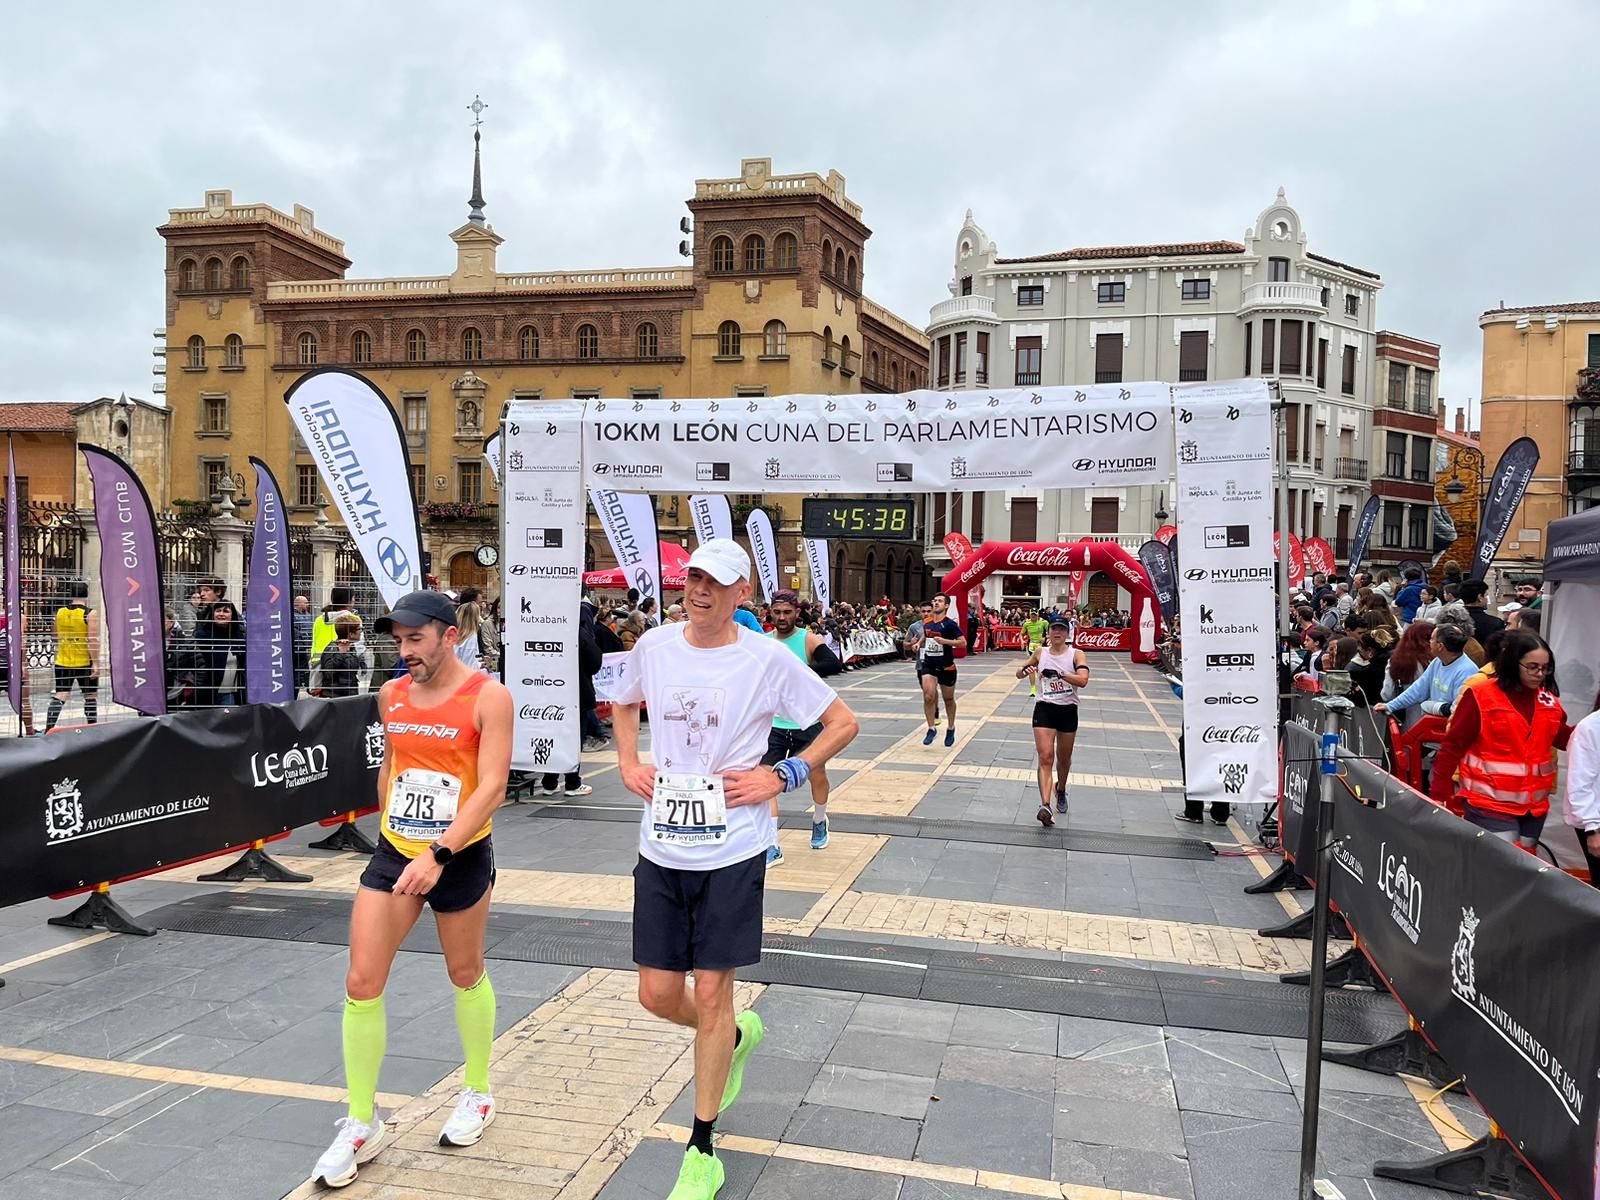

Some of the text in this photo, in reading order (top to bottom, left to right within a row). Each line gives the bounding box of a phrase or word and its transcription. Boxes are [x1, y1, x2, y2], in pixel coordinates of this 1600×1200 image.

[595, 412, 1156, 442] 10KM LEÓN CUNA DEL PARLAMENTARISMO
[613, 465, 662, 473] HYUNDAI
[1099, 458, 1156, 468] HYUNDAI
[1007, 546, 1072, 566] Coca-Cola
[531, 567, 578, 575] HYUNDAI
[586, 574, 613, 584] Coca-Cola
[1212, 568, 1271, 578] HYUNDAI
[521, 615, 567, 624] kutxabank
[1201, 624, 1259, 634] kutxabank
[1076, 632, 1120, 648] Coca-Cola
[1204, 692, 1258, 704] emico
[520, 704, 566, 720] Coca-Cola
[387, 722, 460, 739] ESPAÑA
[1203, 725, 1262, 743] Coca-Cola
[86, 795, 210, 832] AYUNTAMIENTO DE LEÓN
[404, 793, 434, 820] 213
[667, 799, 705, 825] 270
[1479, 992, 1584, 1114] AYUNTAMIENTO DE LEÓN
